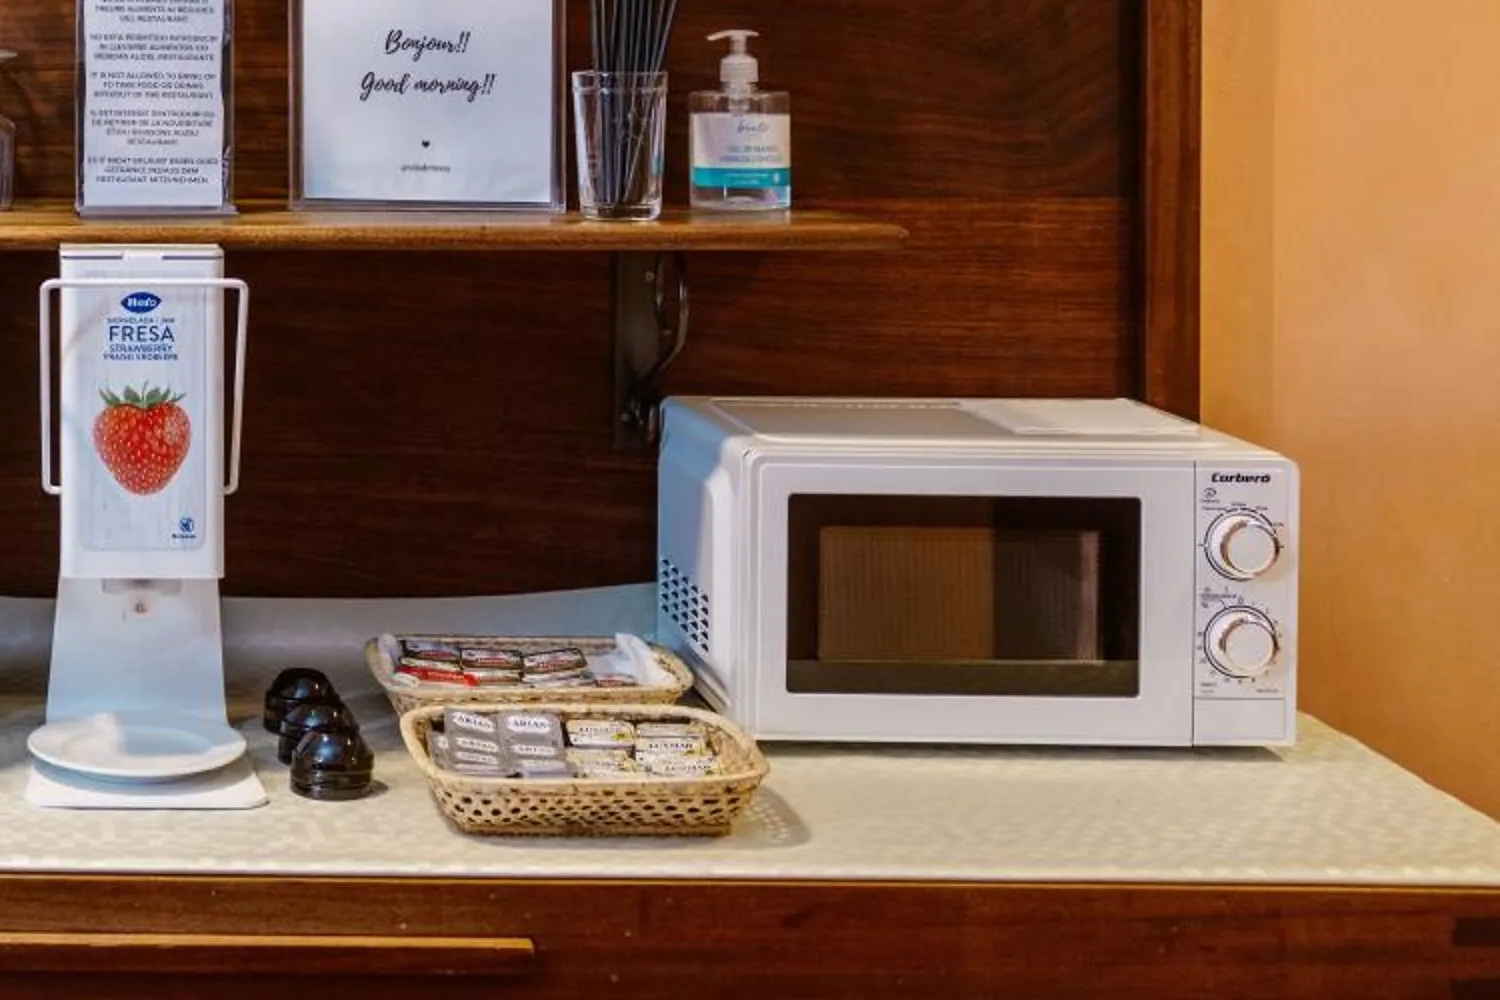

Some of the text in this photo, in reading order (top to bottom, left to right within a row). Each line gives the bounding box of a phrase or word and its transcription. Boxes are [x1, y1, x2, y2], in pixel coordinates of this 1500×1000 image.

[385, 29, 471, 62] Bonjour!!
[360, 72, 497, 103] Good morning!!
[109, 325, 175, 342] FRESA
